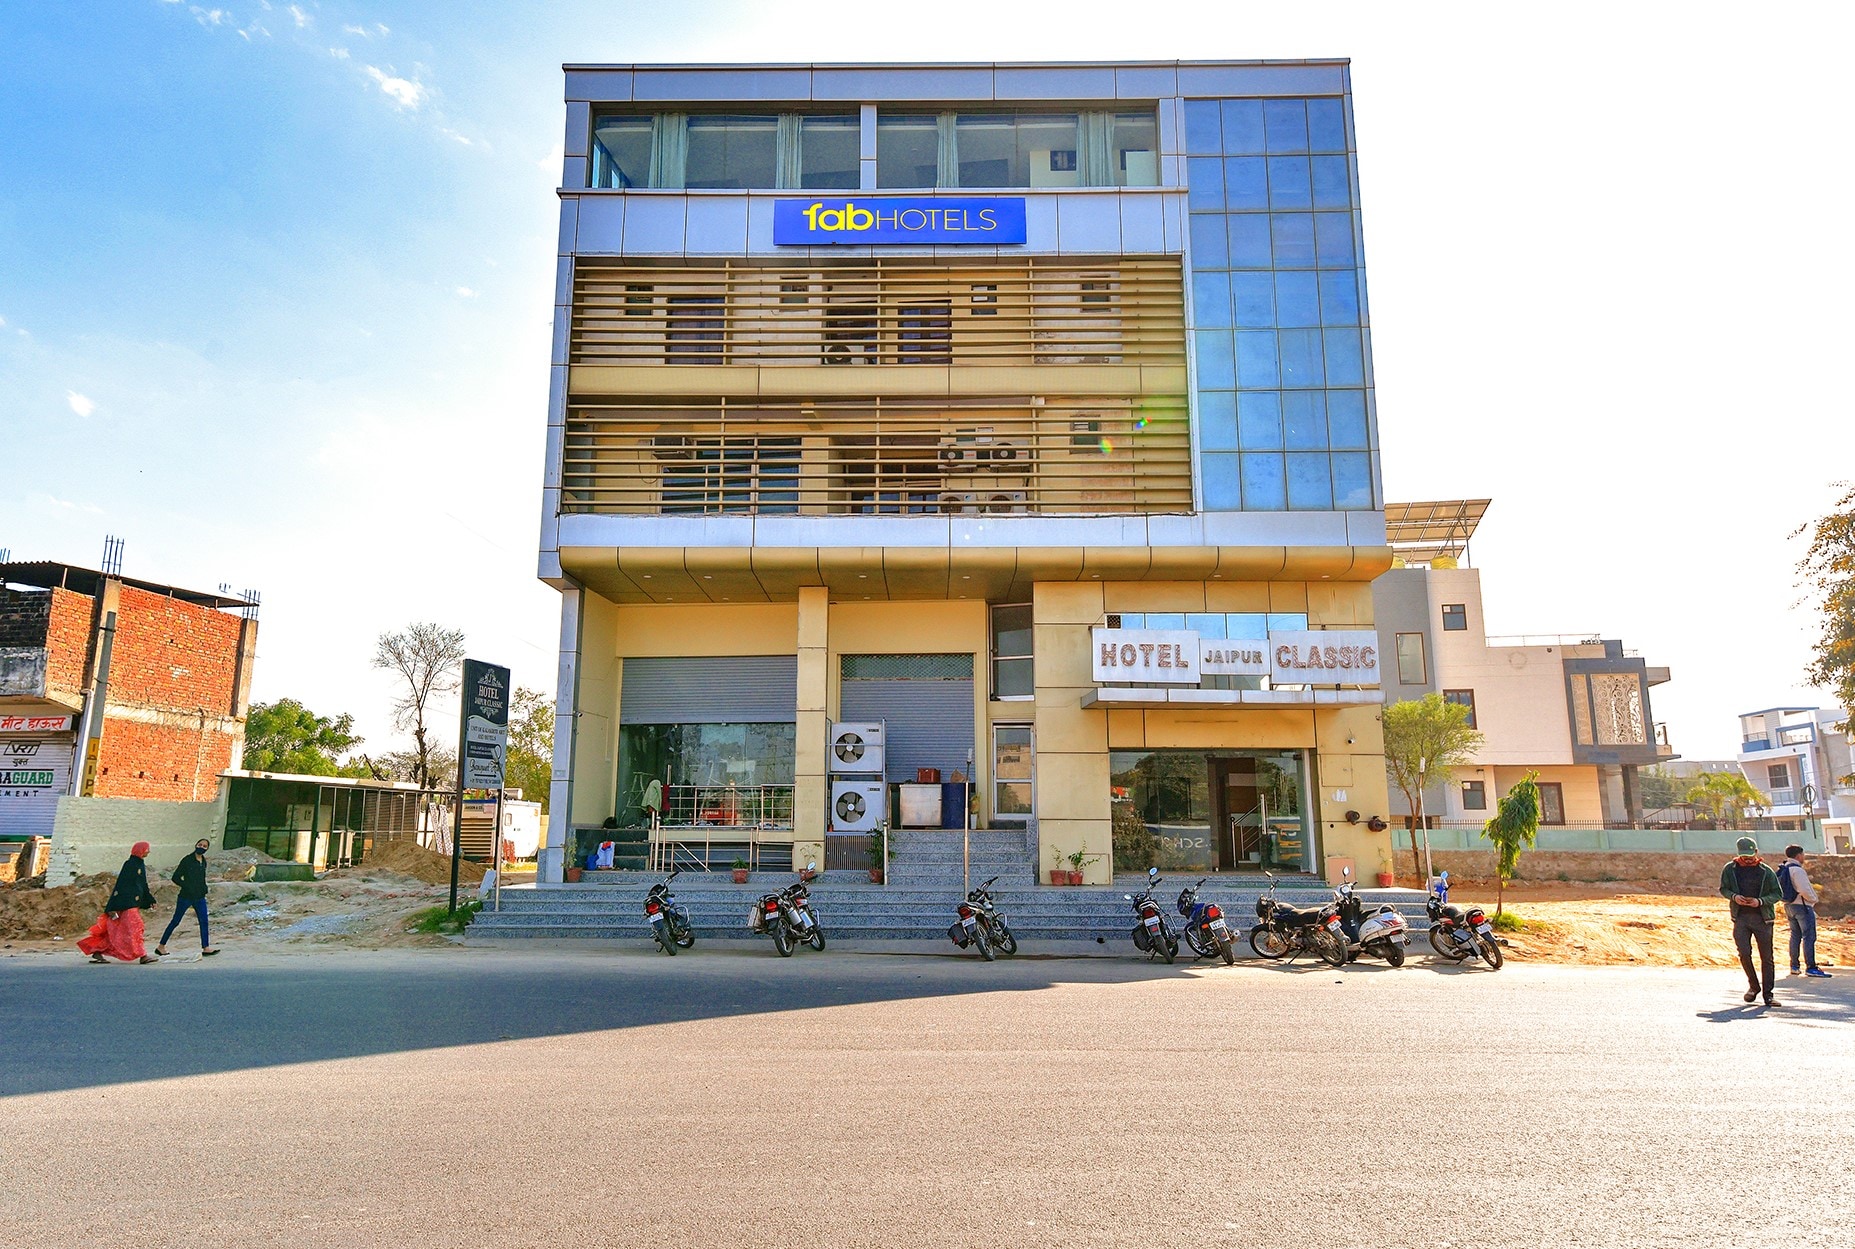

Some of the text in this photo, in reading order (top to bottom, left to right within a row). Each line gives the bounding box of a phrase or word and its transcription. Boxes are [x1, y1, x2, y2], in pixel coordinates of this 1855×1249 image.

[1100, 643, 1377, 669] HOTEL JAIPUR CLASSIC
[479, 685, 499, 699] HOTEL
[487, 699, 503, 709] CLASSIC
[1, 715, 67, 731] मीट हाऊस
[0, 771, 54, 784] AGUARD
